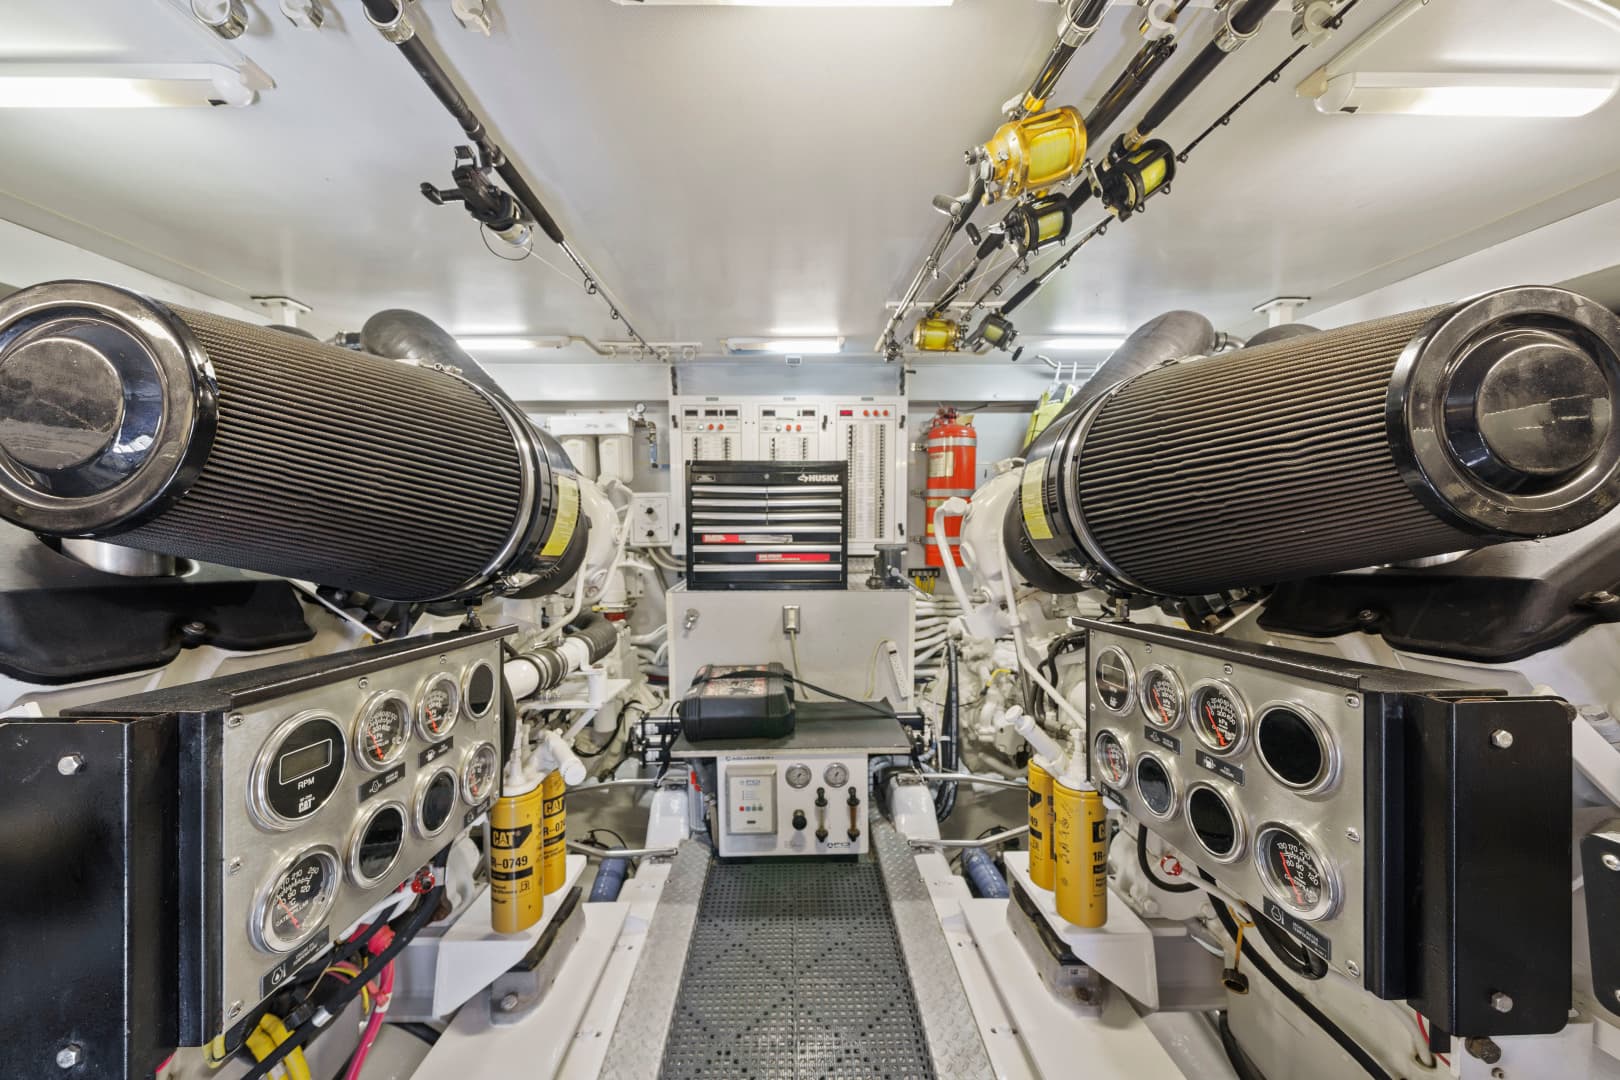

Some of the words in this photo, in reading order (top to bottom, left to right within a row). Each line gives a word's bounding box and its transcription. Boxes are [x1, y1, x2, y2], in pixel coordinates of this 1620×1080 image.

[808, 473, 840, 482] HUSKY
[297, 776, 315, 790] RPM
[298, 798, 314, 814] CAT
[544, 797, 563, 816] CAT
[492, 830, 515, 847] CAT
[491, 855, 528, 870] R-0749
[1307, 872, 1319, 886] 120
[287, 889, 297, 900] 90
